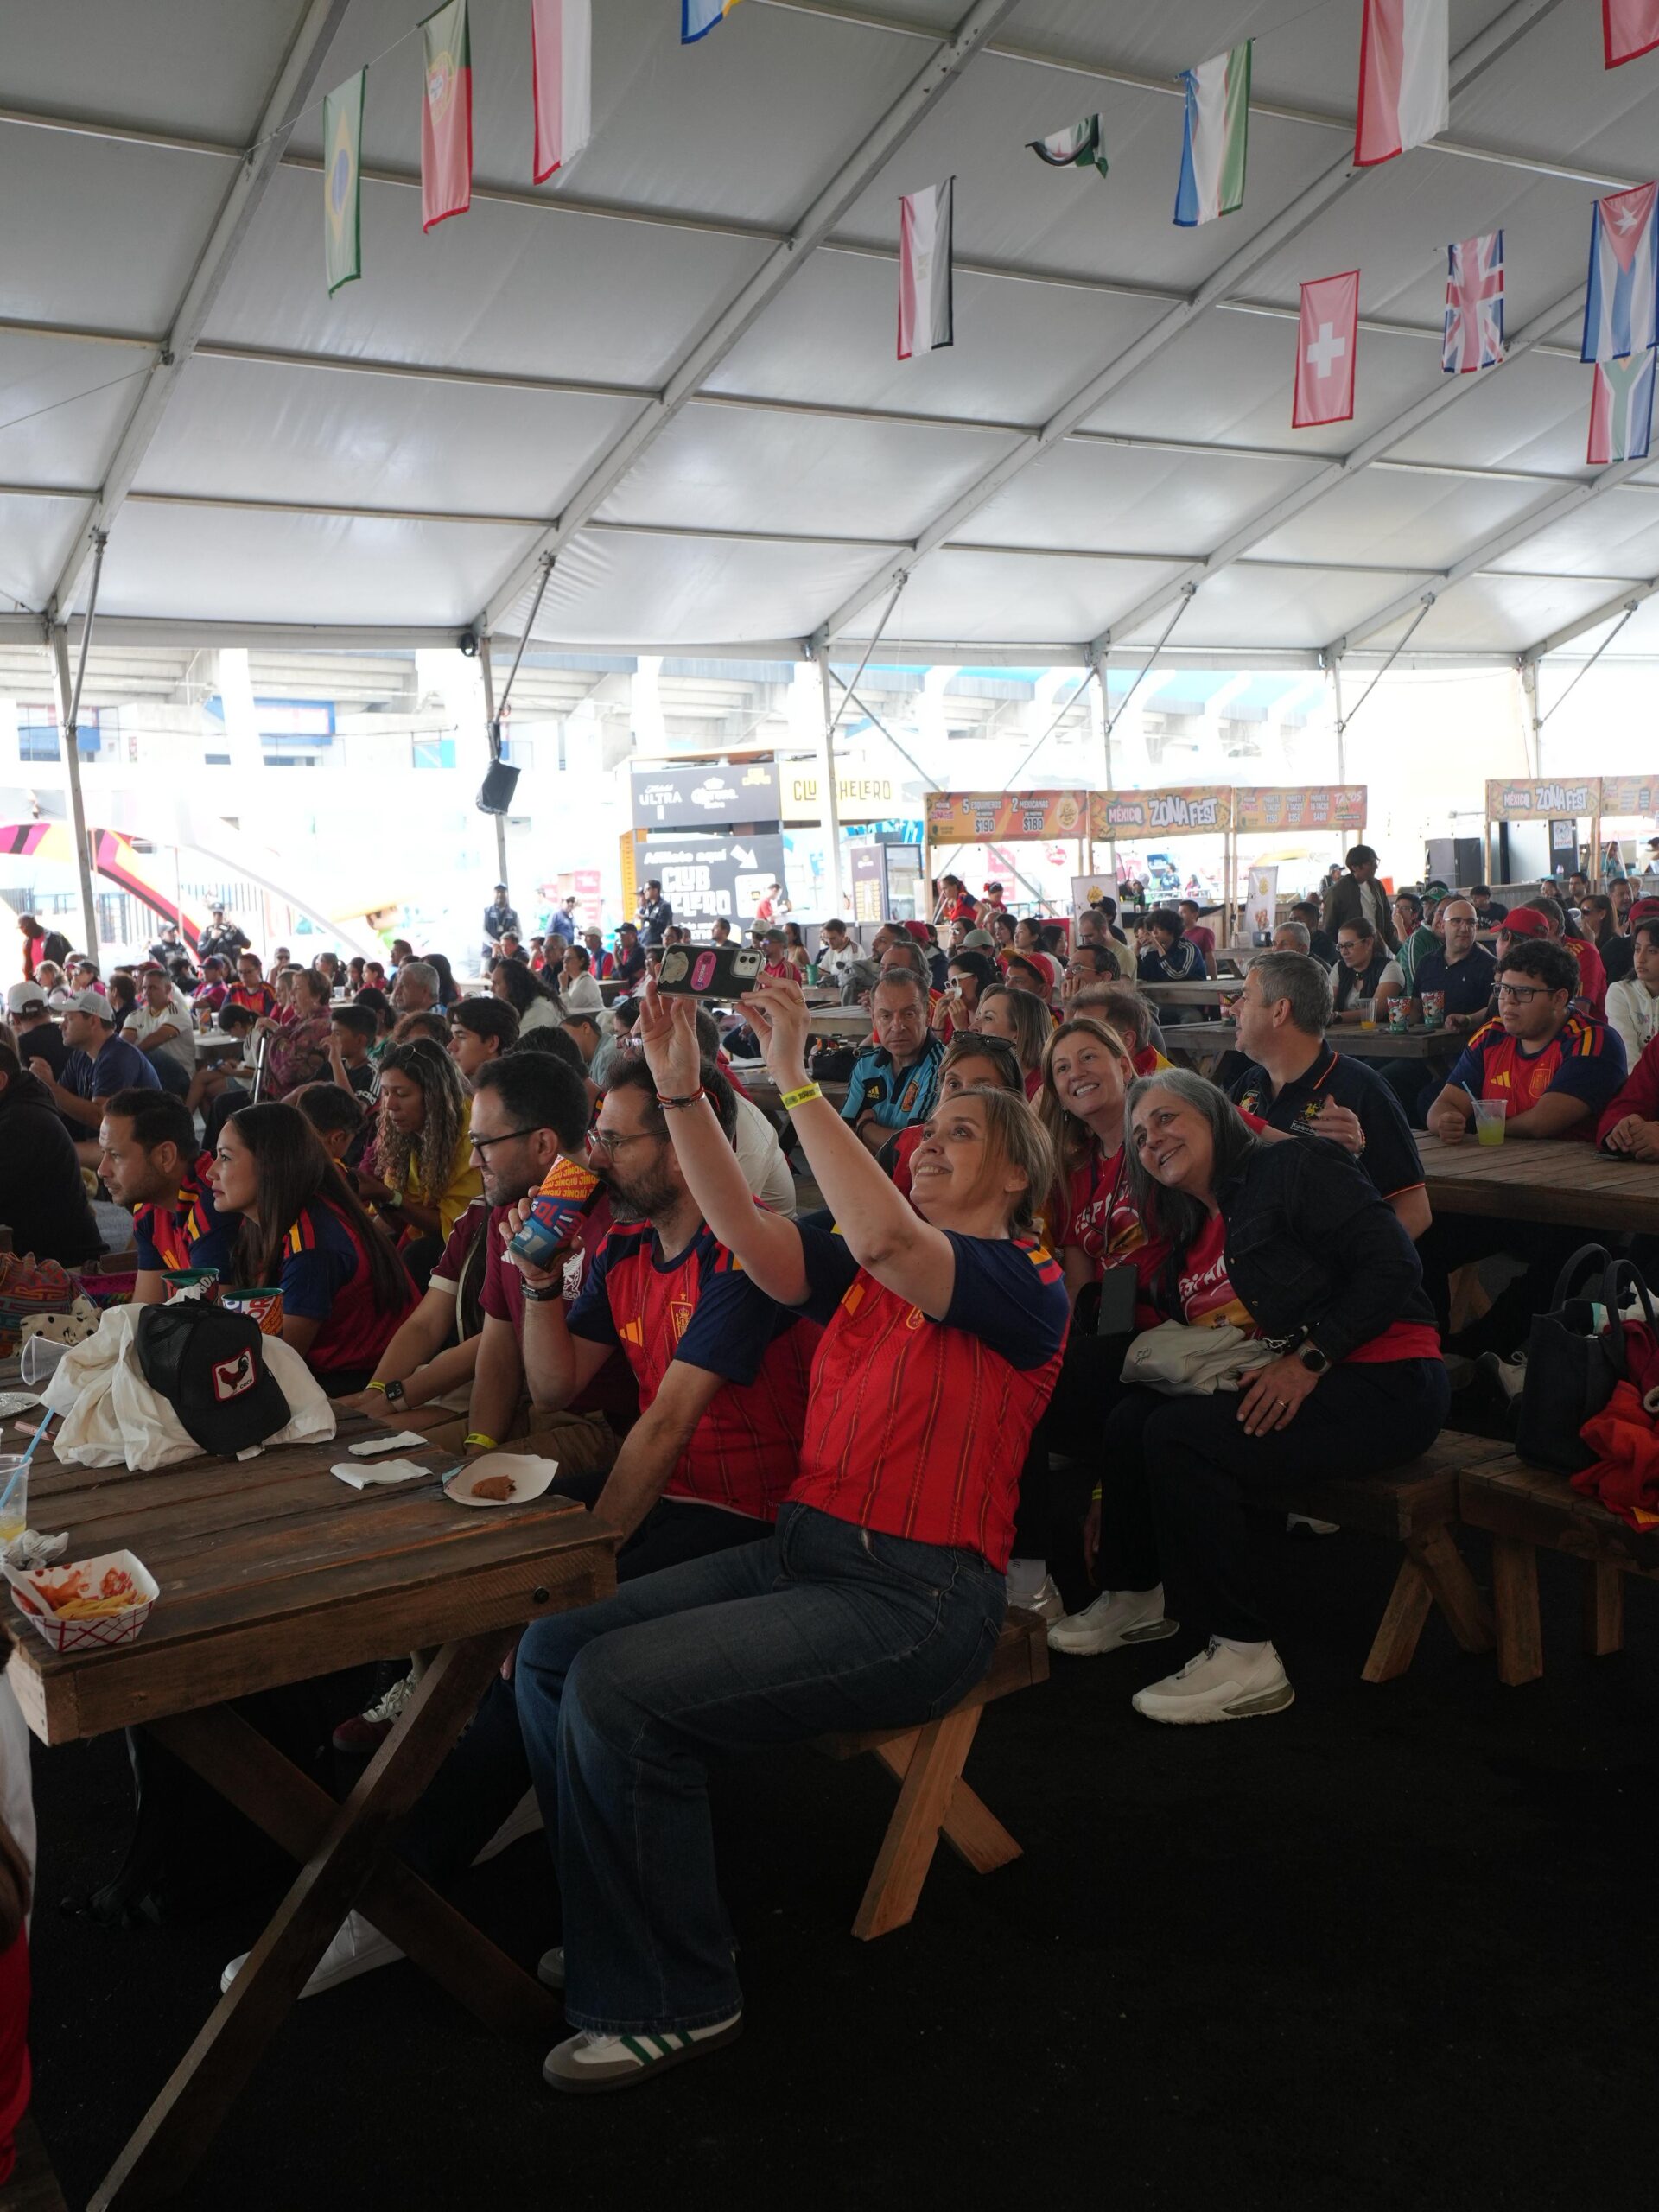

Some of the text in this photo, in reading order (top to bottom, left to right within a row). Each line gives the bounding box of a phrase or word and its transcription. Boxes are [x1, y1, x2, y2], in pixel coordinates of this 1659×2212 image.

[639, 791, 683, 805] ULTRA
[793, 780, 891, 801] CLU HELERO
[963, 798, 969, 814] 5
[1012, 798, 1019, 813] 2
[1108, 804, 1143, 823] MÉXICO
[975, 819, 995, 833] $190
[1023, 818, 1043, 831] $180
[662, 865, 710, 891] CLUB
[664, 890, 732, 917] ELERO
[1179, 1249, 1227, 1302] ESPAÑ
